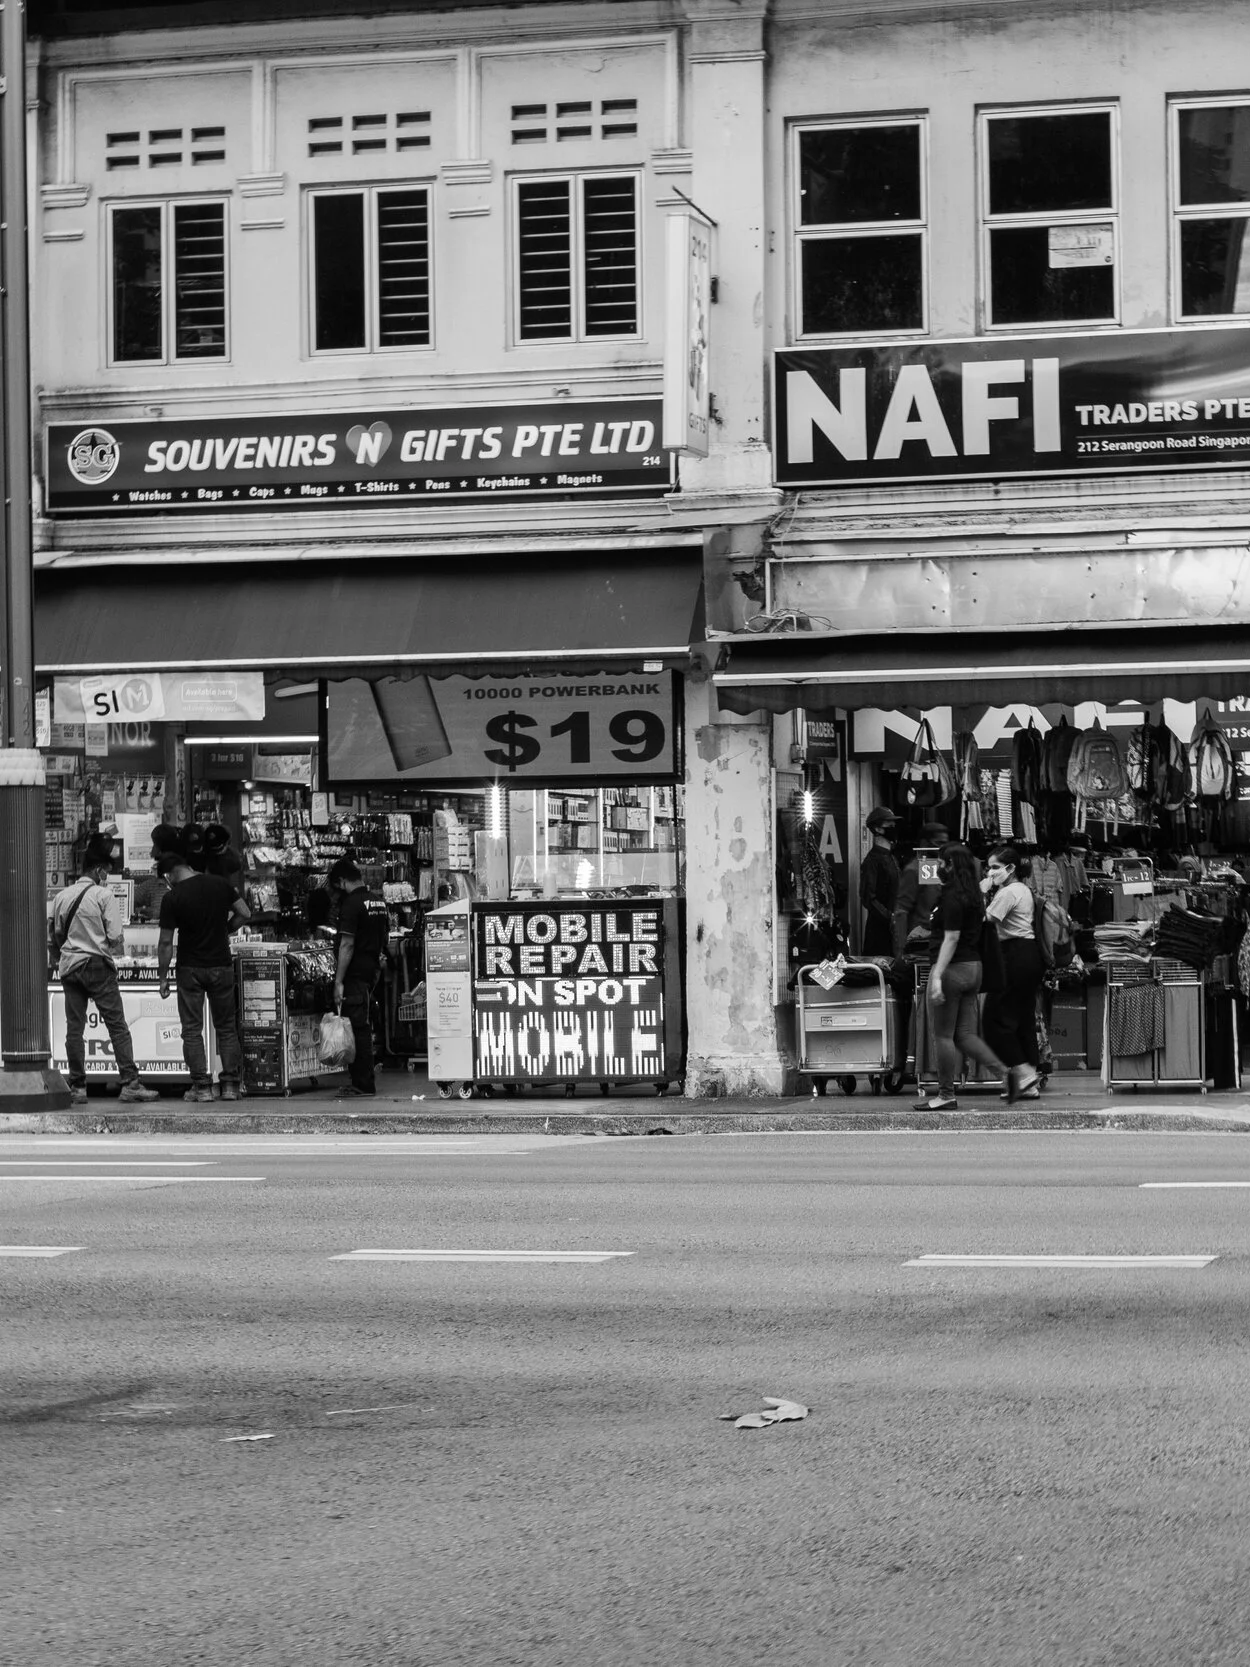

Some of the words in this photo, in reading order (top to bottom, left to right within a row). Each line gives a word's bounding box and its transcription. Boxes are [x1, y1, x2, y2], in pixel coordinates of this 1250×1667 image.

[786, 357, 1062, 464] NAFI
[1075, 401, 1199, 426] TRADERS
[144, 433, 337, 473] SOUVENIRS
[355, 431, 383, 464] N
[400, 426, 503, 462] GIFTS
[511, 423, 584, 458] PTE
[590, 420, 655, 454] LTD
[1077, 441, 1100, 453] 212
[1101, 437, 1165, 454] Serangoon
[1166, 436, 1197, 449] Road
[642, 456, 661, 466] 214
[129, 489, 172, 501] Watches
[197, 488, 223, 500] Bags
[249, 487, 274, 498] Caps
[300, 484, 328, 496] Mugs
[355, 481, 399, 493] T-Shirts
[425, 479, 450, 490] Pens
[476, 476, 531, 489] Keychains
[557, 473, 603, 486] Magnets
[463, 686, 522, 700] 10000
[529, 682, 661, 699] POWERBANK
[483, 709, 667, 773] $19
[807, 721, 835, 738] TRADERS
[484, 912, 659, 945] MOBILE
[485, 943, 659, 975] REPAIR
[438, 992, 459, 1004] $40
[554, 979, 647, 1005] SPOT
[480, 1010, 659, 1076] MOBILE
[146, 1062, 186, 1071] AVAILABLE
